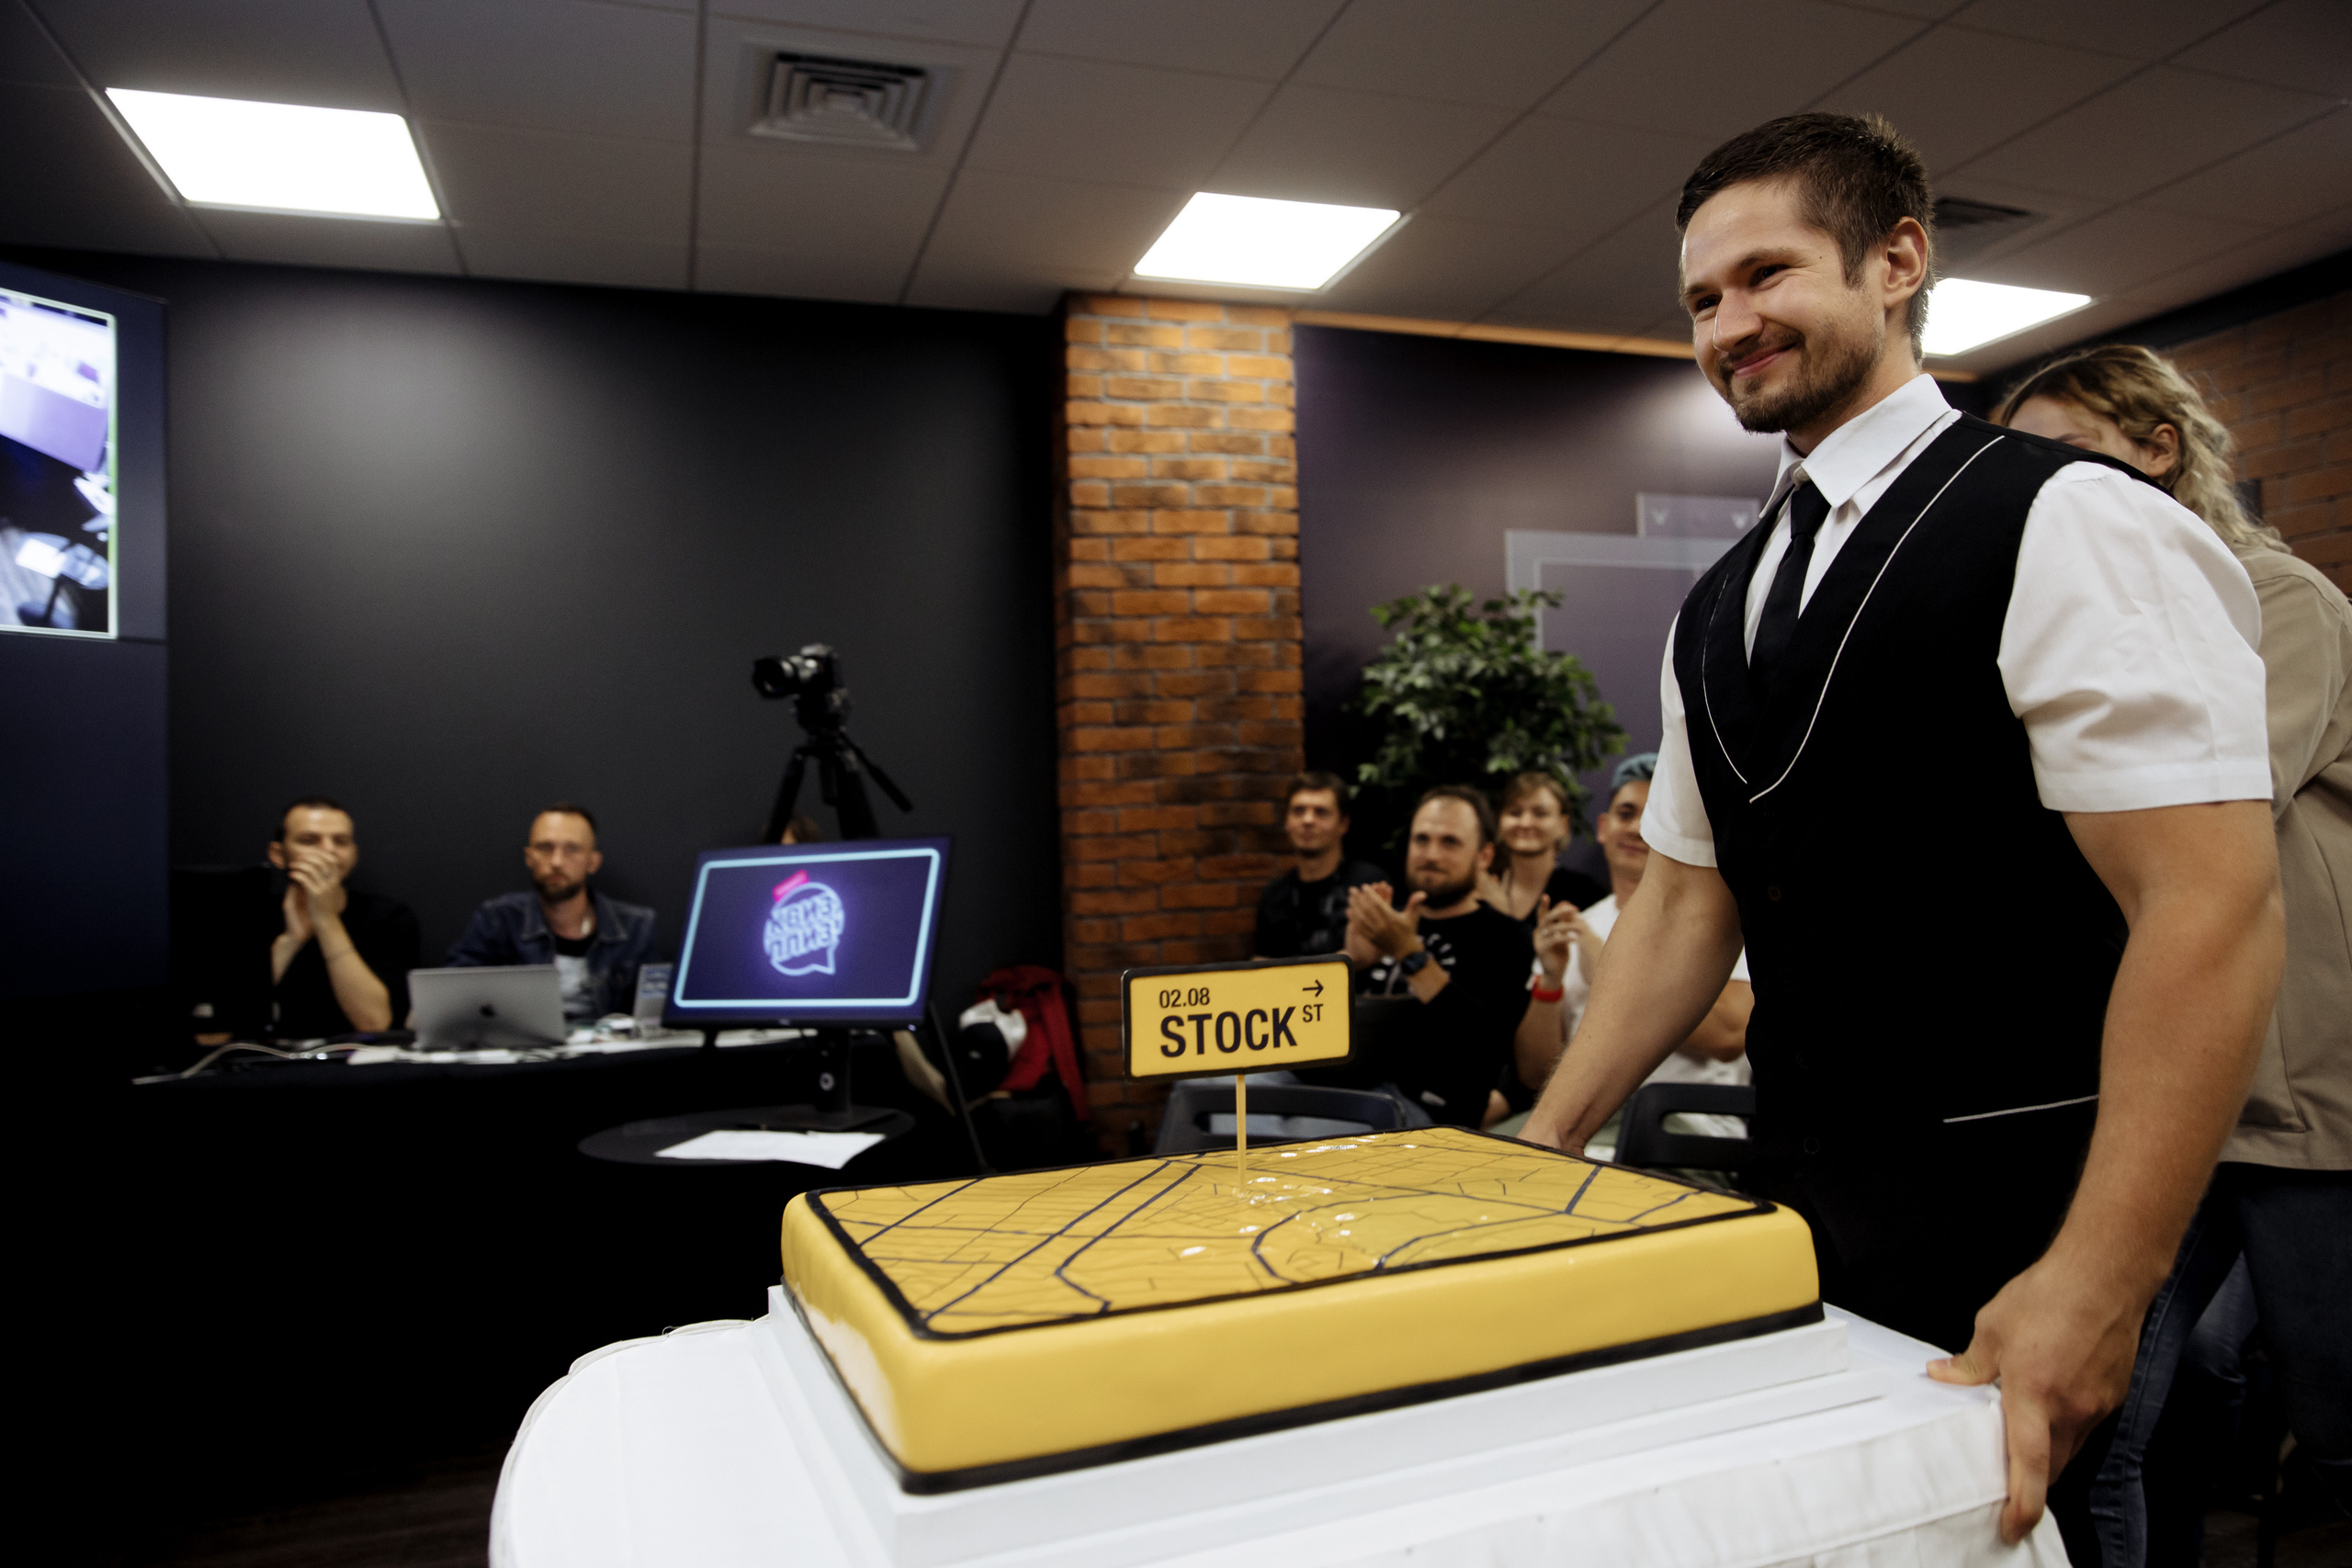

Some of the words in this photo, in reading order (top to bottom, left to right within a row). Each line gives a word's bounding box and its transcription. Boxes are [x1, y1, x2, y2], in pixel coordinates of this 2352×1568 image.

[1159, 987, 1210, 1009] 02.08
[1159, 1006, 1297, 1058] STOCK
[1302, 1003, 1324, 1023] ST
